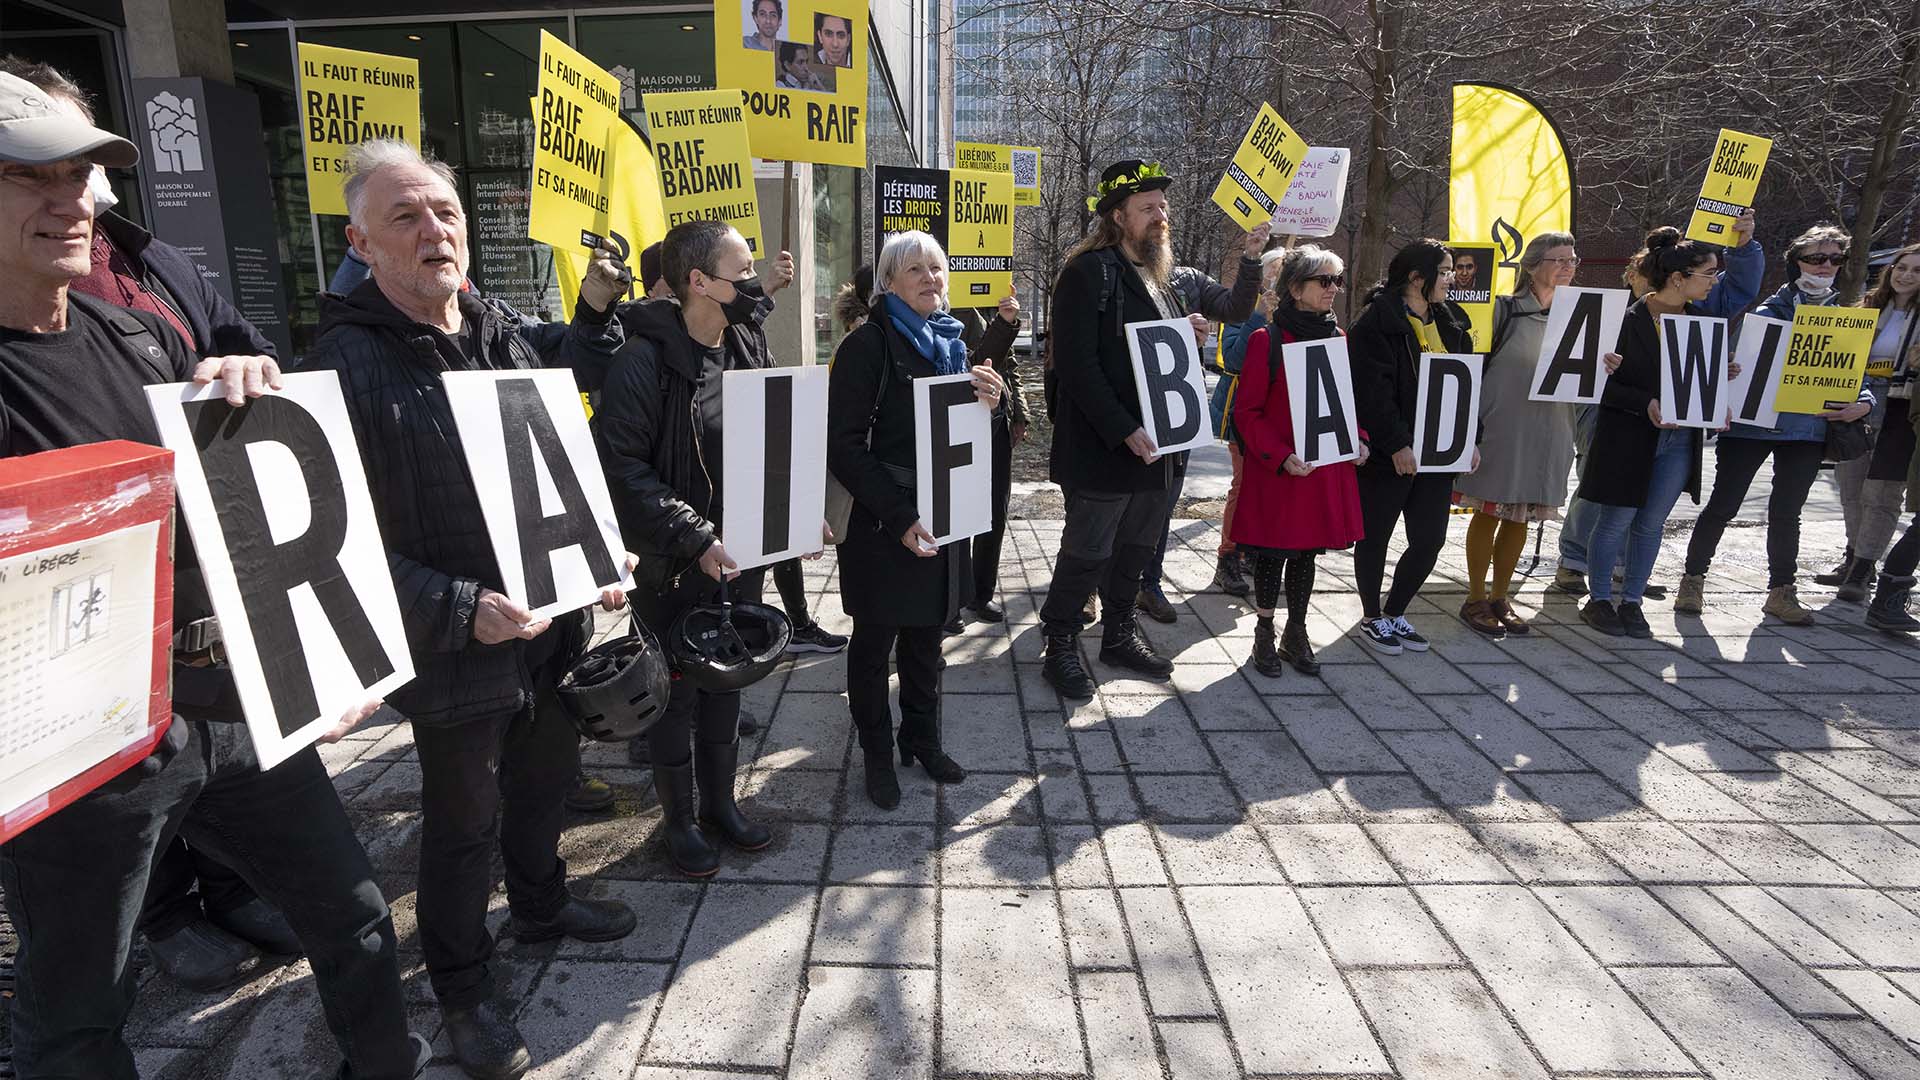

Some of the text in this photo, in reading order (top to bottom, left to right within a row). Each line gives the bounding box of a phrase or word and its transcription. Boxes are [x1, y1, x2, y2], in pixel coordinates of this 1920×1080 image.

[304, 60, 415, 90] IL FAUT RÉUNIR
[544, 52, 617, 113] IL FAUT RÉUNIR
[686, 75, 701, 84] DU
[307, 90, 365, 121] RAIF
[542, 86, 584, 135] RAIF
[651, 104, 742, 128] IL FAUT RÉUNIR
[309, 116, 404, 146] BADAWI
[806, 102, 859, 144] RAIF
[1258, 114, 1286, 147] RAIF
[540, 118, 606, 179] BADAWI
[656, 138, 705, 170] RAIF
[959, 147, 996, 162] LIBÉRONS
[1250, 128, 1294, 178] BADAWI
[1720, 138, 1748, 160] RAIF
[313, 157, 329, 172] ET
[958, 160, 969, 168] LES
[1256, 164, 1266, 179] À
[1714, 156, 1759, 180] BADAWI
[476, 182, 510, 190] Amnistie
[538, 168, 608, 214] ET SA FAMILLE!
[662, 162, 742, 198] BADAWI
[884, 180, 938, 200] DÉFENDRE
[1724, 181, 1732, 196] À
[156, 191, 212, 199] DÉVELOPPEMENT
[954, 180, 988, 203] RAIF
[158, 200, 188, 208] DURABLE
[670, 202, 754, 228] ET SA FAMILLE!
[884, 200, 942, 216] LES DROITS
[954, 202, 1008, 225] BADAWI
[479, 216, 528, 226] Conseil régio
[480, 224, 528, 232] l'environnem
[884, 216, 930, 232] HUMAINS
[492, 231, 526, 239] Montréal
[978, 230, 984, 248] À
[481, 244, 537, 252] ENvironnemen
[482, 252, 516, 260] JEUnesse
[482, 264, 518, 274] Équiterre
[484, 278, 545, 287] Option consom
[485, 291, 540, 300] Regroupement
[504, 298, 530, 306] onseils
[1446, 290, 1490, 301] ESUISRAIF
[1796, 315, 1874, 330] IL FAUT RÉUNIR
[1537, 292, 1604, 399] A
[1791, 333, 1833, 352] RAIF
[1664, 318, 1724, 423] W
[1787, 350, 1856, 370] BADAWI
[1740, 322, 1784, 421] I
[1783, 374, 1858, 389] ET SA FAMILLE!
[1136, 326, 1201, 448] B
[1304, 344, 1354, 464] A
[1420, 358, 1473, 467] D
[762, 374, 793, 557] I
[928, 380, 979, 540] F
[494, 378, 622, 611] A
[181, 394, 396, 740] R
